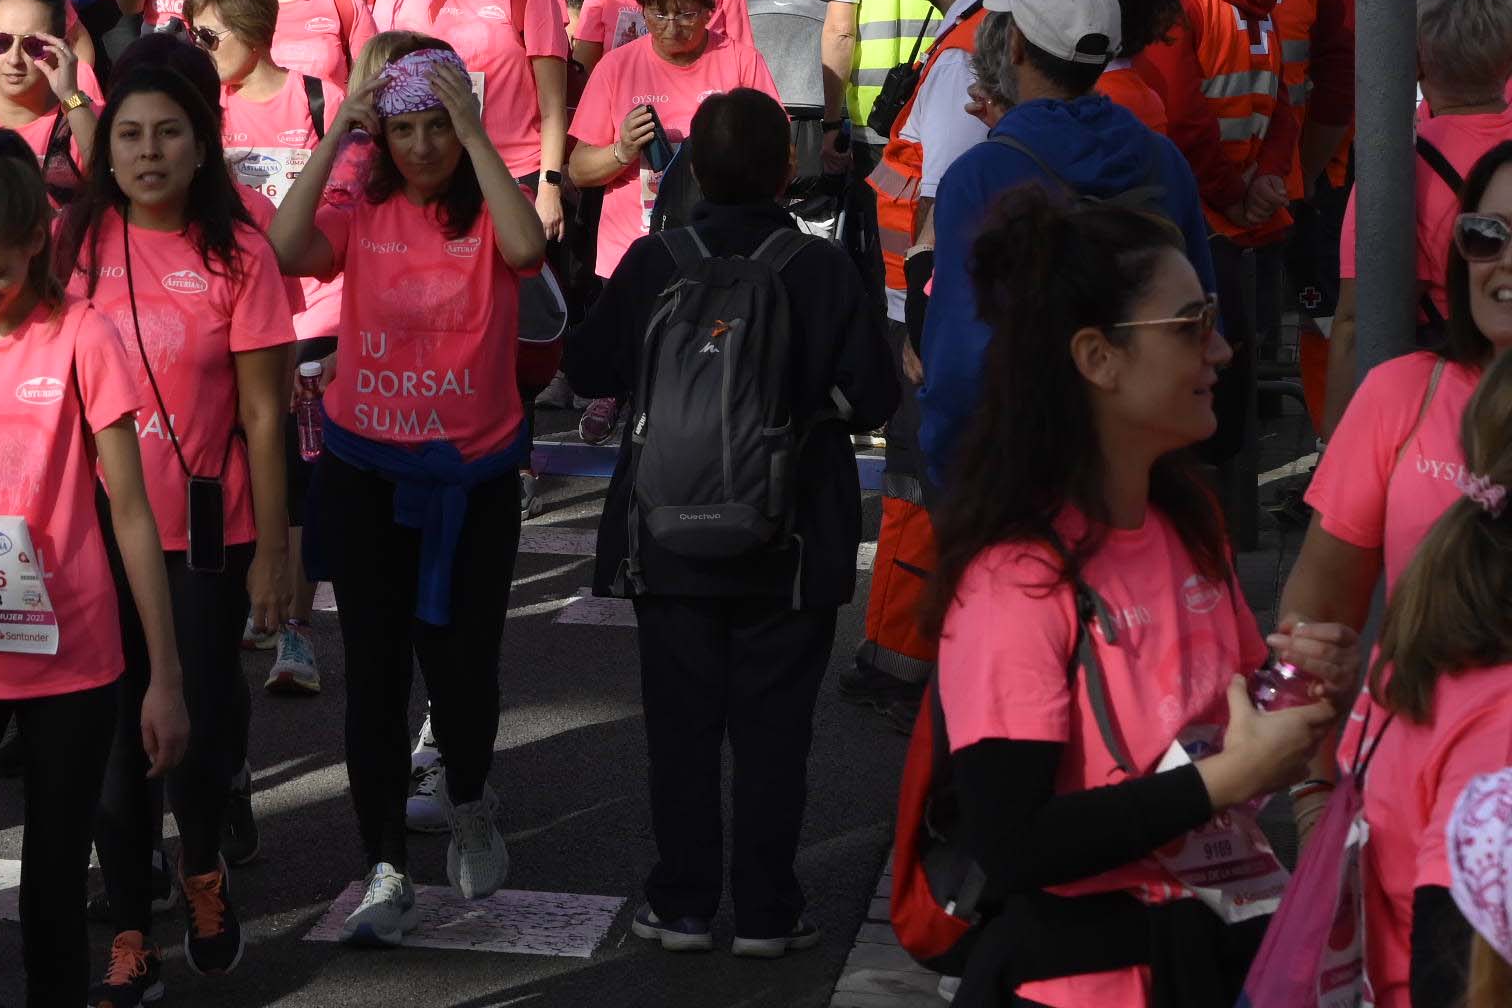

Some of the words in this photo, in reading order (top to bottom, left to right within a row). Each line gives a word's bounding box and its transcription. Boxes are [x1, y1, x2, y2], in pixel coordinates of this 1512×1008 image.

[632, 95, 669, 104] OYSHO
[361, 239, 409, 254] OYSHO
[164, 277, 206, 290] ASTURIANA
[357, 367, 476, 397] DORSAL
[354, 404, 445, 436] SUMA
[679, 512, 721, 521] Quechua
[5, 630, 49, 643] Santander
